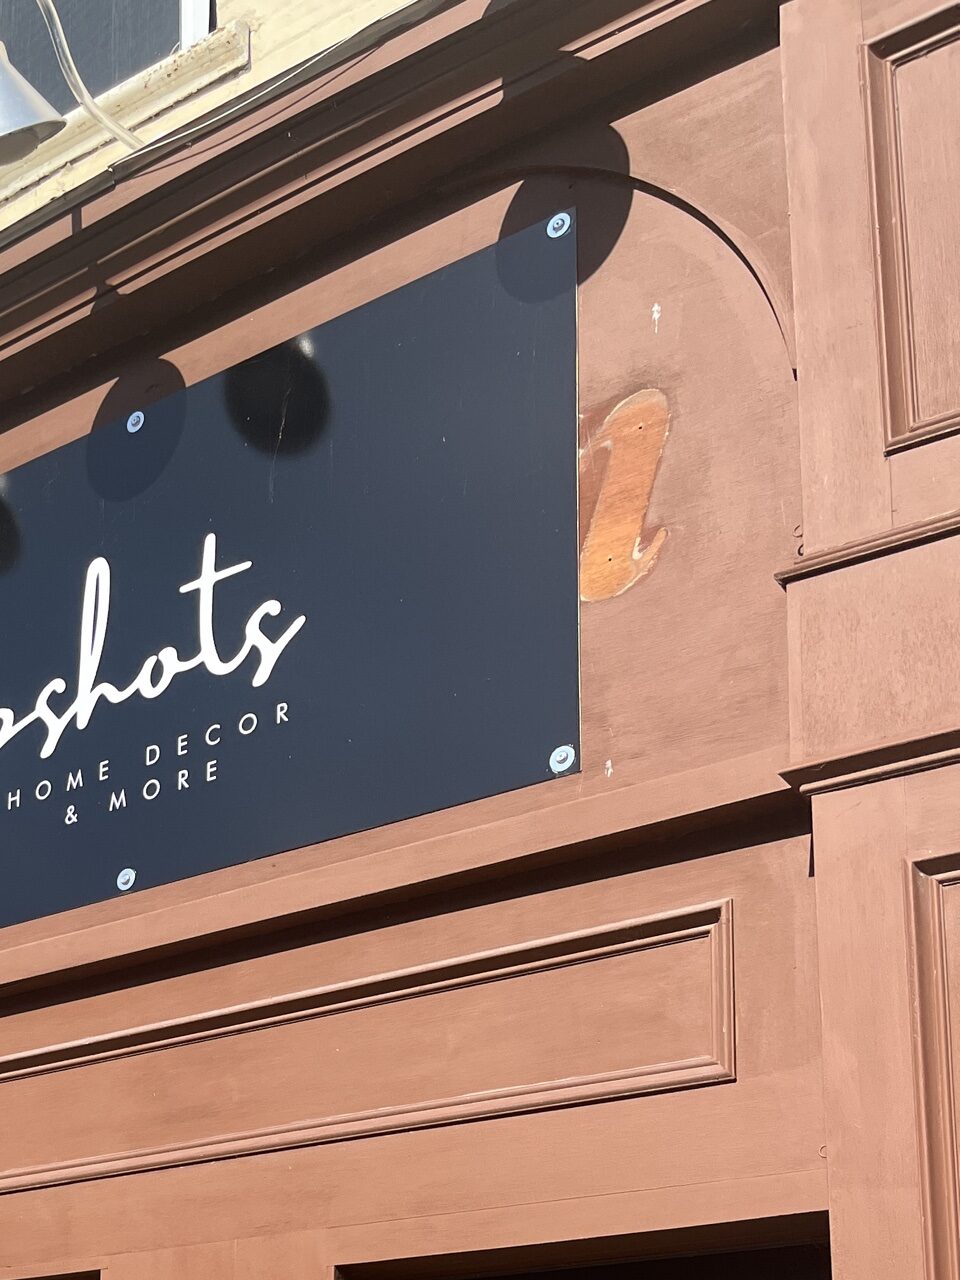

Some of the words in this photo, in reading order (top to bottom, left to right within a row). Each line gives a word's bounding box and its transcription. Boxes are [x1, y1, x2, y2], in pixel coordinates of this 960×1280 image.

[7, 759, 110, 810] HOME
[145, 702, 289, 766] DECOR
[64, 804, 78, 825] &
[109, 759, 218, 812] MORE
